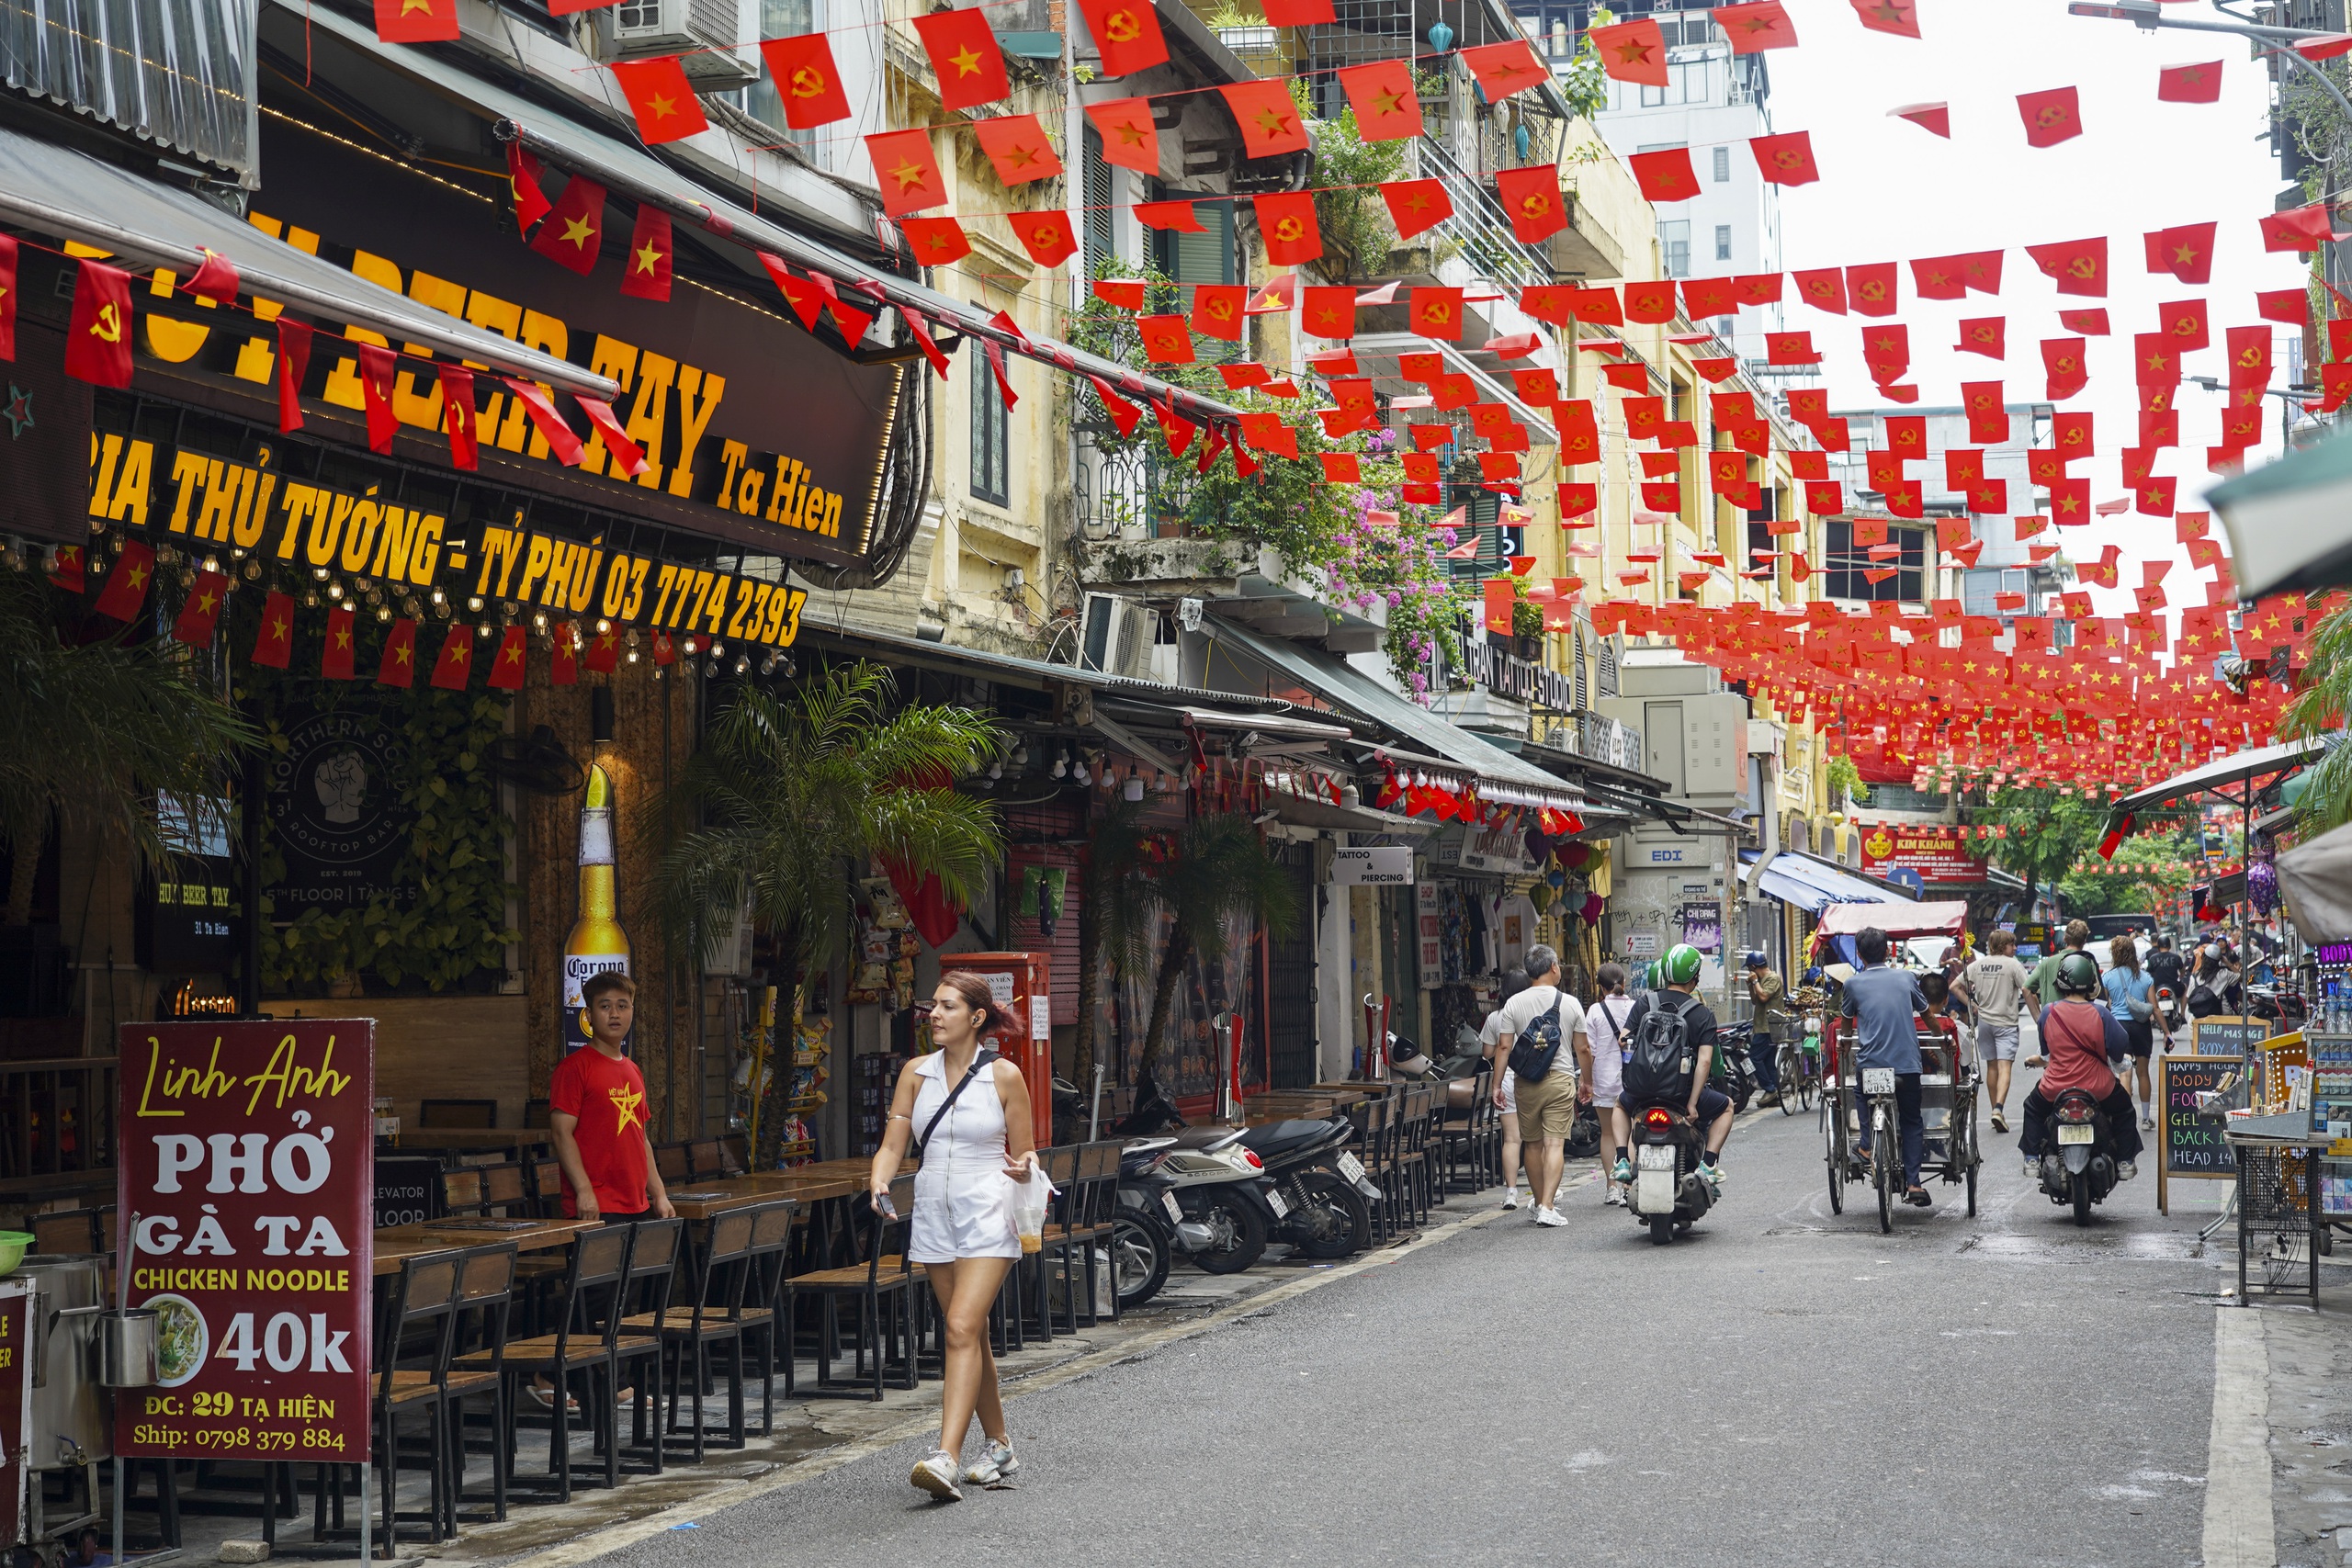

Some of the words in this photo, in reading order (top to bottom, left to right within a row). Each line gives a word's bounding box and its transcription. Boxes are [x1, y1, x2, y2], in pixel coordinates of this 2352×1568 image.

[579, 334, 727, 498] TAY
[717, 438, 765, 516] Ta
[765, 455, 842, 538] Hien
[89, 431, 154, 525] IA
[168, 447, 276, 547] THỦ
[277, 485, 445, 586] TƯỚNG
[476, 511, 525, 598] TỶ
[517, 536, 604, 613] PHÚ
[602, 554, 651, 621] 03
[650, 564, 732, 634] 7774
[726, 580, 807, 647] 2393
[289, 821, 360, 852] ROOFTOP
[368, 819, 393, 844] BAR
[1896, 840, 1917, 850] KIM
[1918, 837, 1955, 851] KHÁNH
[1338, 851, 1370, 859] TATTOO
[1652, 851, 1682, 862] EDI
[183, 885, 208, 906] BEER
[212, 886, 229, 907] TAY
[290, 888, 344, 902] FLOOR
[1689, 958, 1700, 972] Grab
[2199, 1024, 2222, 1034] HELLO
[2224, 1029, 2263, 1039] MASAGE
[136, 1036, 237, 1117] Linh
[243, 1034, 351, 1116] Anh
[2168, 1063, 2201, 1071] HAPPY
[2172, 1075, 2212, 1087] BODY
[2171, 1113, 2199, 1126] GEL
[2174, 1131, 2213, 1145] BACK
[152, 1110, 334, 1194] PHỞ
[2174, 1150, 2211, 1165] HEAD
[1187, 1169, 1231, 1178] SCOOPY
[375, 1209, 424, 1226] LOOR
[135, 1203, 237, 1256] GÀ
[254, 1215, 350, 1257] TA
[134, 1269, 237, 1291] CHICKEN
[246, 1269, 349, 1292] NOODLE
[214, 1312, 354, 1373] 40k
[145, 1396, 184, 1416] ĐC:
[192, 1392, 234, 1416] 29
[240, 1398, 270, 1423] TẠ
[278, 1393, 335, 1424] HIỆN
[133, 1425, 188, 1449] Ship:
[196, 1427, 250, 1450] 0798
[256, 1431, 296, 1451] 379
[302, 1428, 345, 1452] 884
